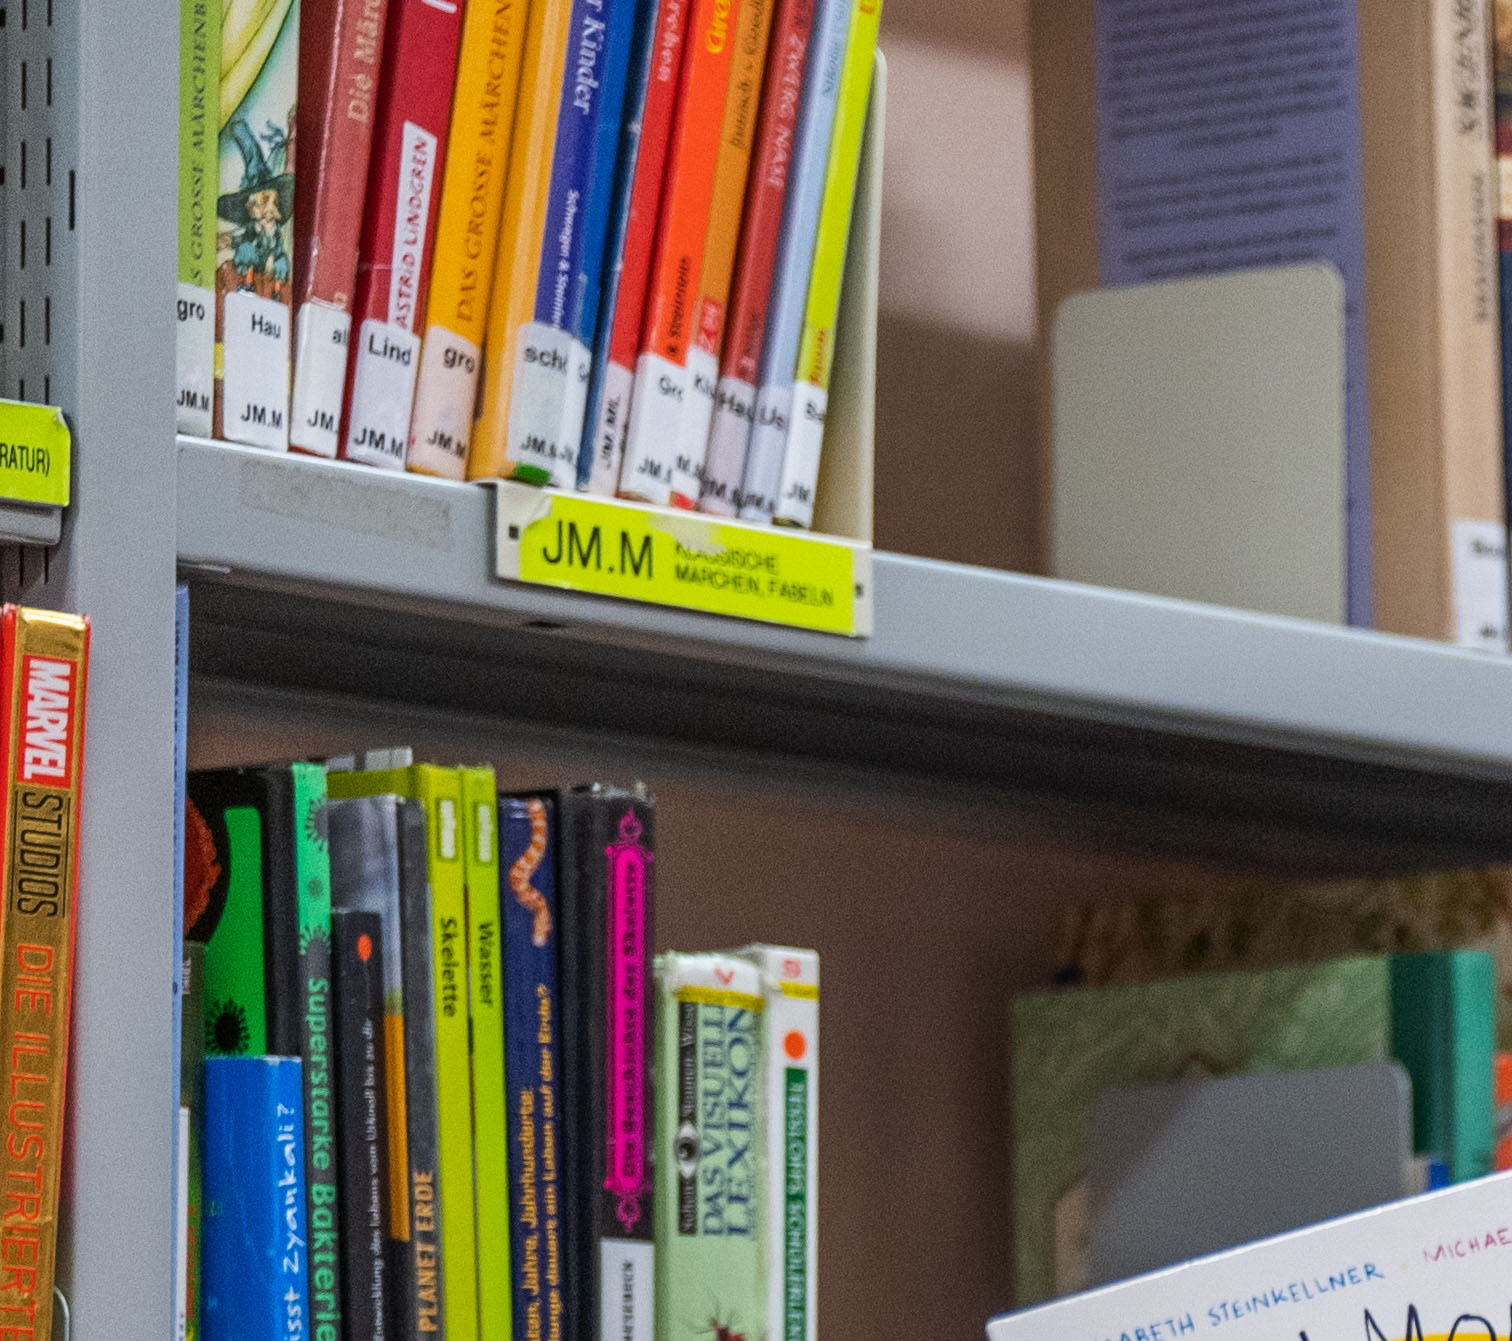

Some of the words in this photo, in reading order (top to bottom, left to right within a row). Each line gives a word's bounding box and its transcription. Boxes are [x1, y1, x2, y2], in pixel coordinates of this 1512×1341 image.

[572, 18, 607, 115] Kinder
[250, 313, 282, 339] Hau
[367, 334, 413, 366] Lind
[444, 347, 476, 375] gro
[241, 403, 284, 430] JM.M
[353, 427, 404, 458] JM.M
[542, 519, 655, 581] JM.M
[23, 657, 72, 781] MARVEL
[16, 790, 65, 918] STUDIOS
[14, 943, 54, 1016] DIE
[440, 917, 459, 1018] Skelette
[477, 921, 496, 1008] Wasser
[305, 977, 335, 1171] Superstarke
[726, 1004, 754, 1237] LEXIKON
[276, 1102, 306, 1276] Zyankali?
[411, 1169, 434, 1233] ERDE
[701, 1171, 729, 1237] DAS
[414, 1241, 439, 1332] PLANET
[1207, 1261, 1386, 1328] STEINKELLNER
